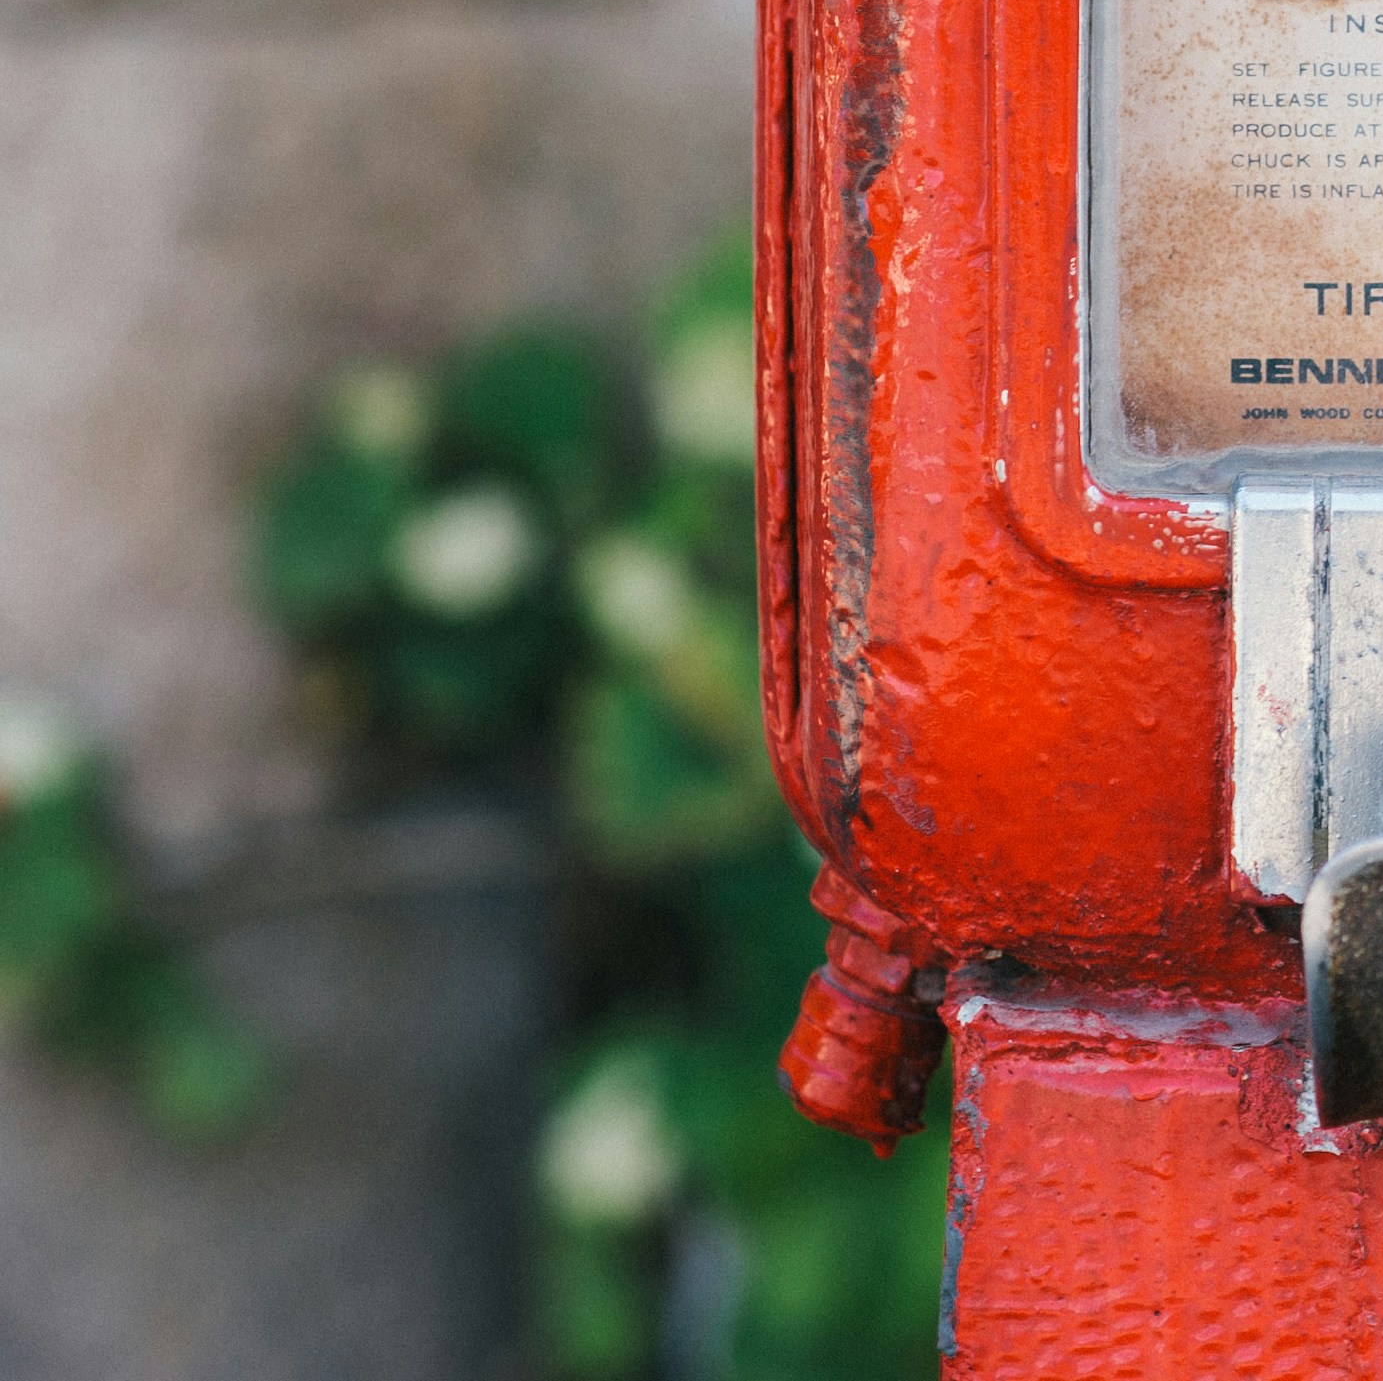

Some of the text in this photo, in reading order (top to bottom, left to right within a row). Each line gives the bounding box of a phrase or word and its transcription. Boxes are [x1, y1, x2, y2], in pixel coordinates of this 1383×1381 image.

[1232, 62, 1270, 78] SET
[1232, 93, 1329, 109] RELEASE
[1232, 123, 1337, 139] PRODUCE
[1354, 124, 1380, 139] AT
[1231, 153, 1311, 169] CHUCK
[1327, 153, 1346, 169] IS
[1233, 184, 1281, 199] TIRE
[1292, 184, 1312, 199] IS
[1242, 408, 1288, 419] JOHN
[1300, 408, 1350, 419] WOOD
